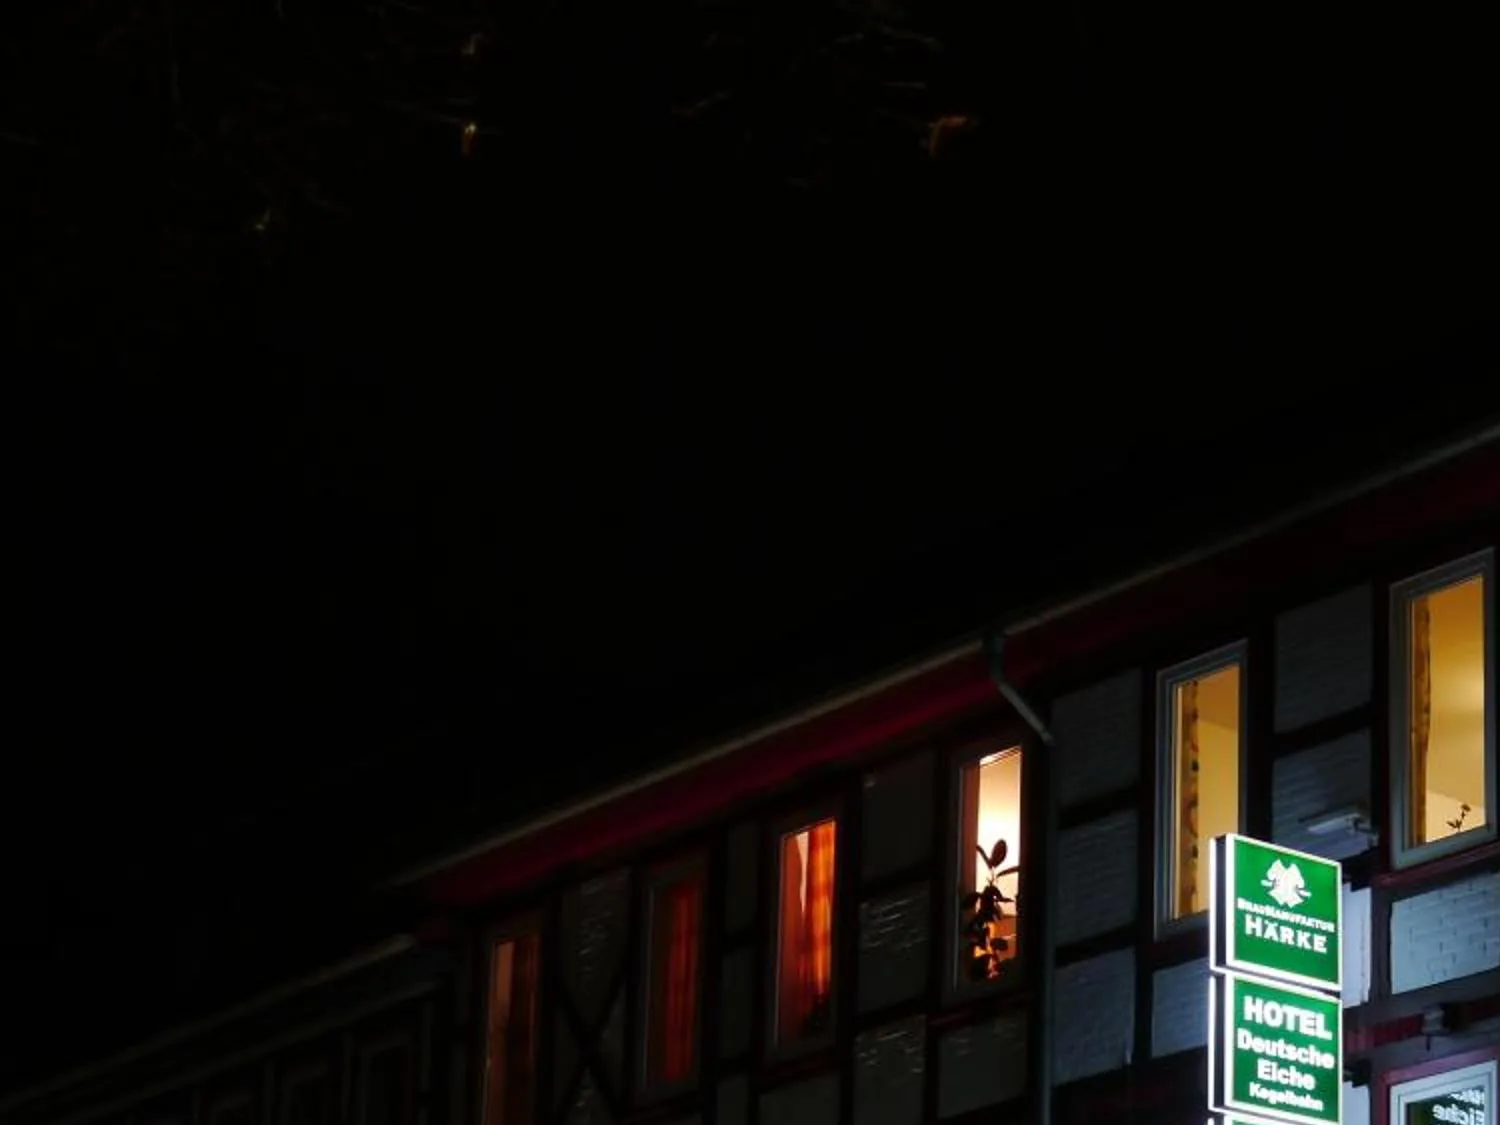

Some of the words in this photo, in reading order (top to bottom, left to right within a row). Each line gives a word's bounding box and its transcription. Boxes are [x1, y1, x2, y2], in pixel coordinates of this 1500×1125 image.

[1245, 914, 1327, 953] HÄRKE
[1244, 996, 1332, 1040] HOTEL
[1237, 1028, 1335, 1069] Deutsche
[1257, 1059, 1316, 1090] Eiche
